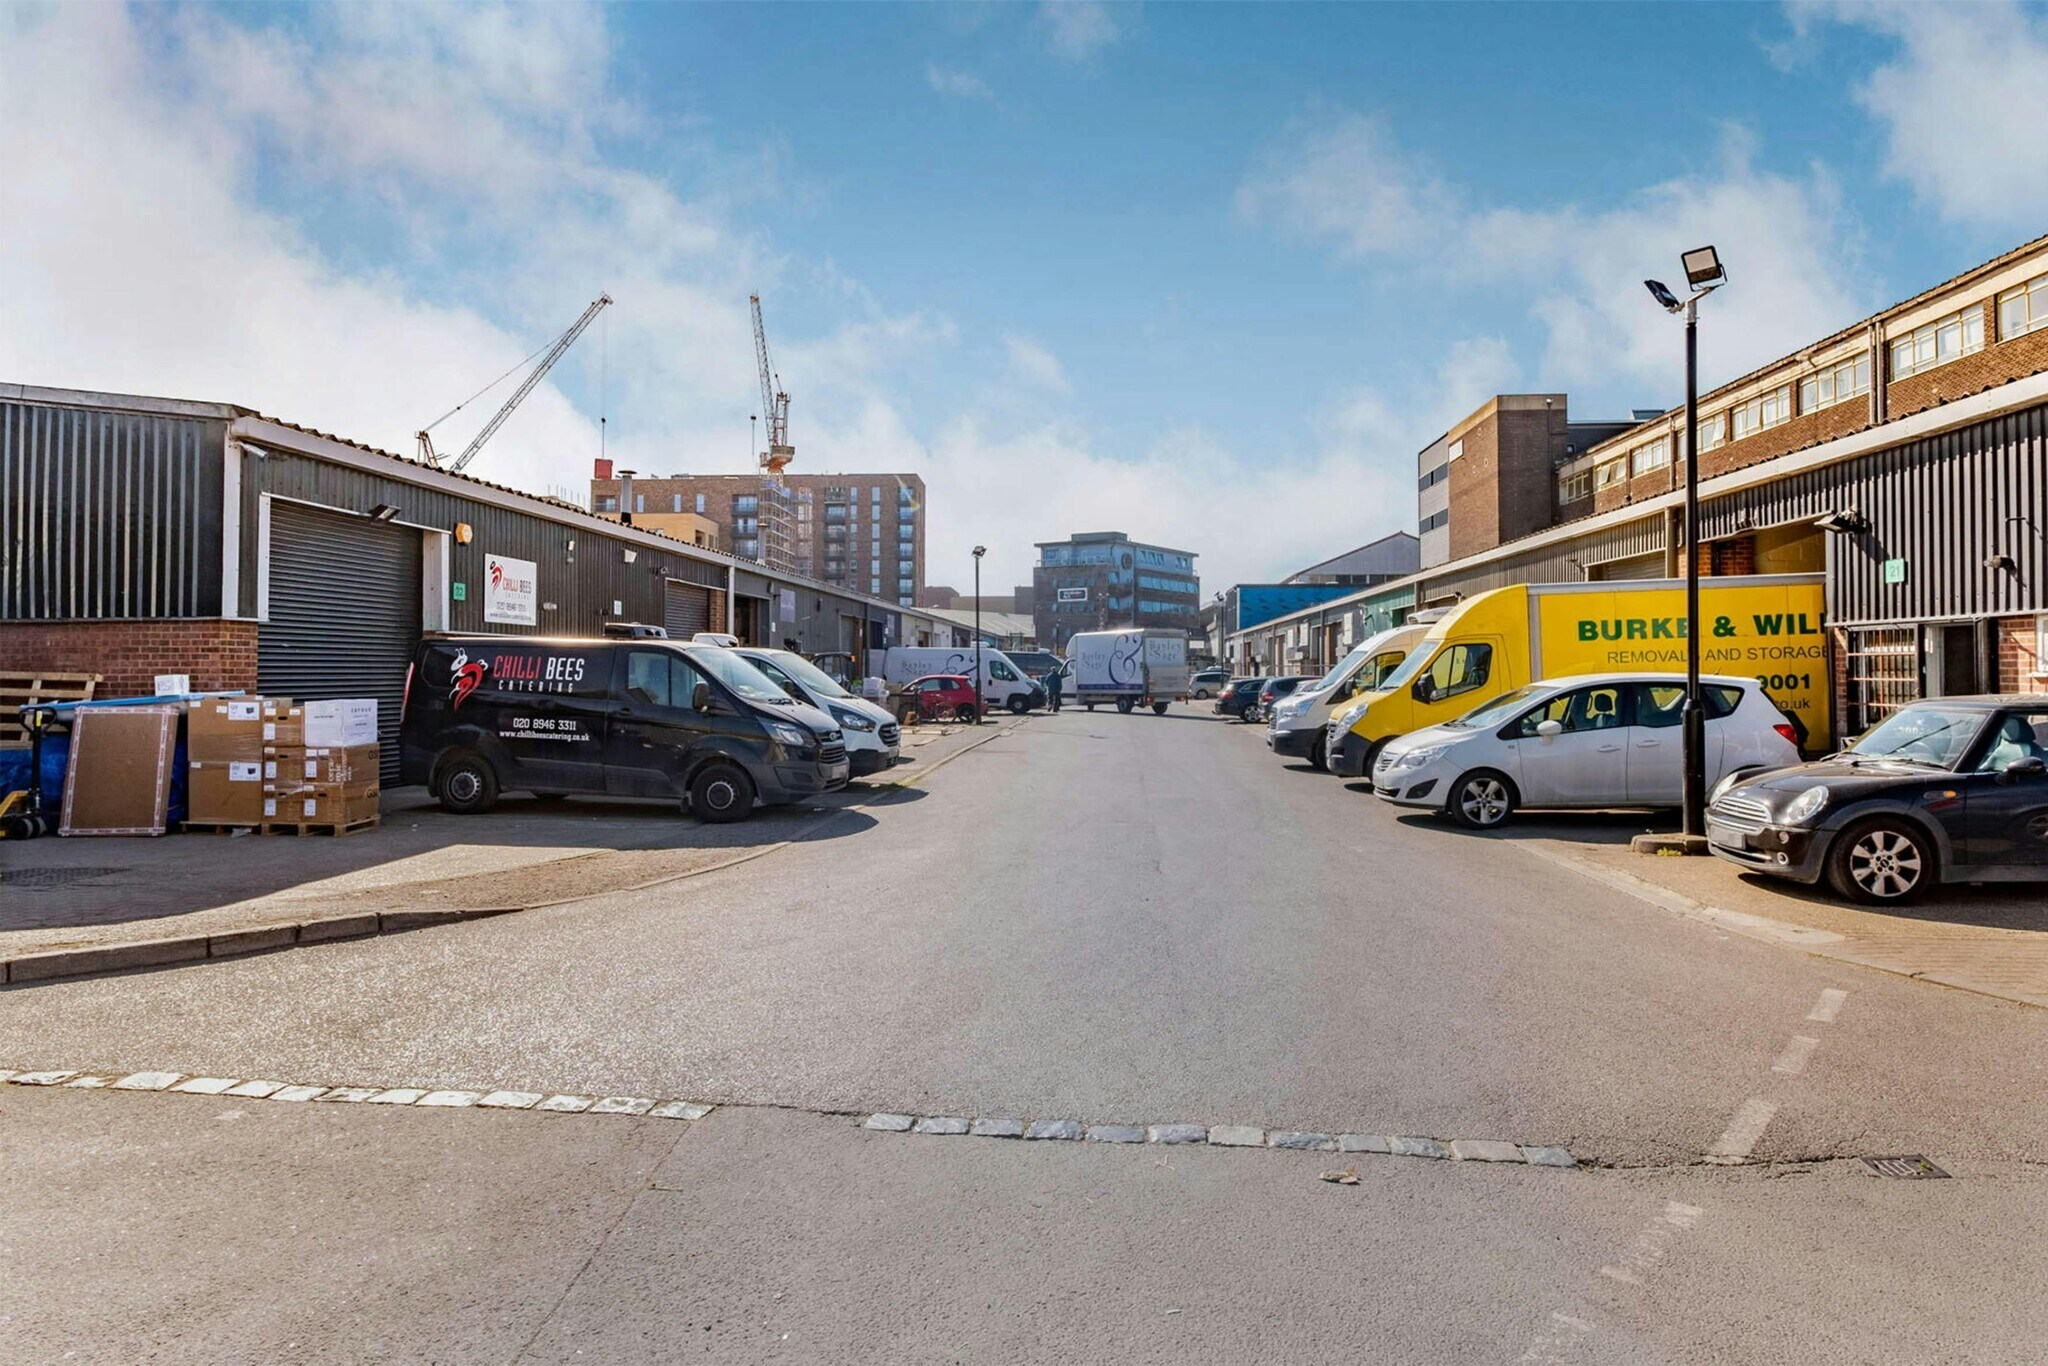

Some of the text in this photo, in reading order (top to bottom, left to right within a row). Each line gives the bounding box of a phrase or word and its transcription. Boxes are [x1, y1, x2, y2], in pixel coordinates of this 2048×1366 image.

[1890, 566, 1900, 577] 21
[1578, 617, 1689, 641] BURKE
[1713, 615, 1737, 638] &
[1607, 649, 1700, 664] REMOVAL
[1705, 647, 1741, 661] AND
[493, 655, 585, 681] CHILLI BEES
[499, 680, 573, 693] CATERING
[513, 718, 576, 731] 020 8946 3311
[500, 730, 590, 742] www.chillibeescatering.co.uk
